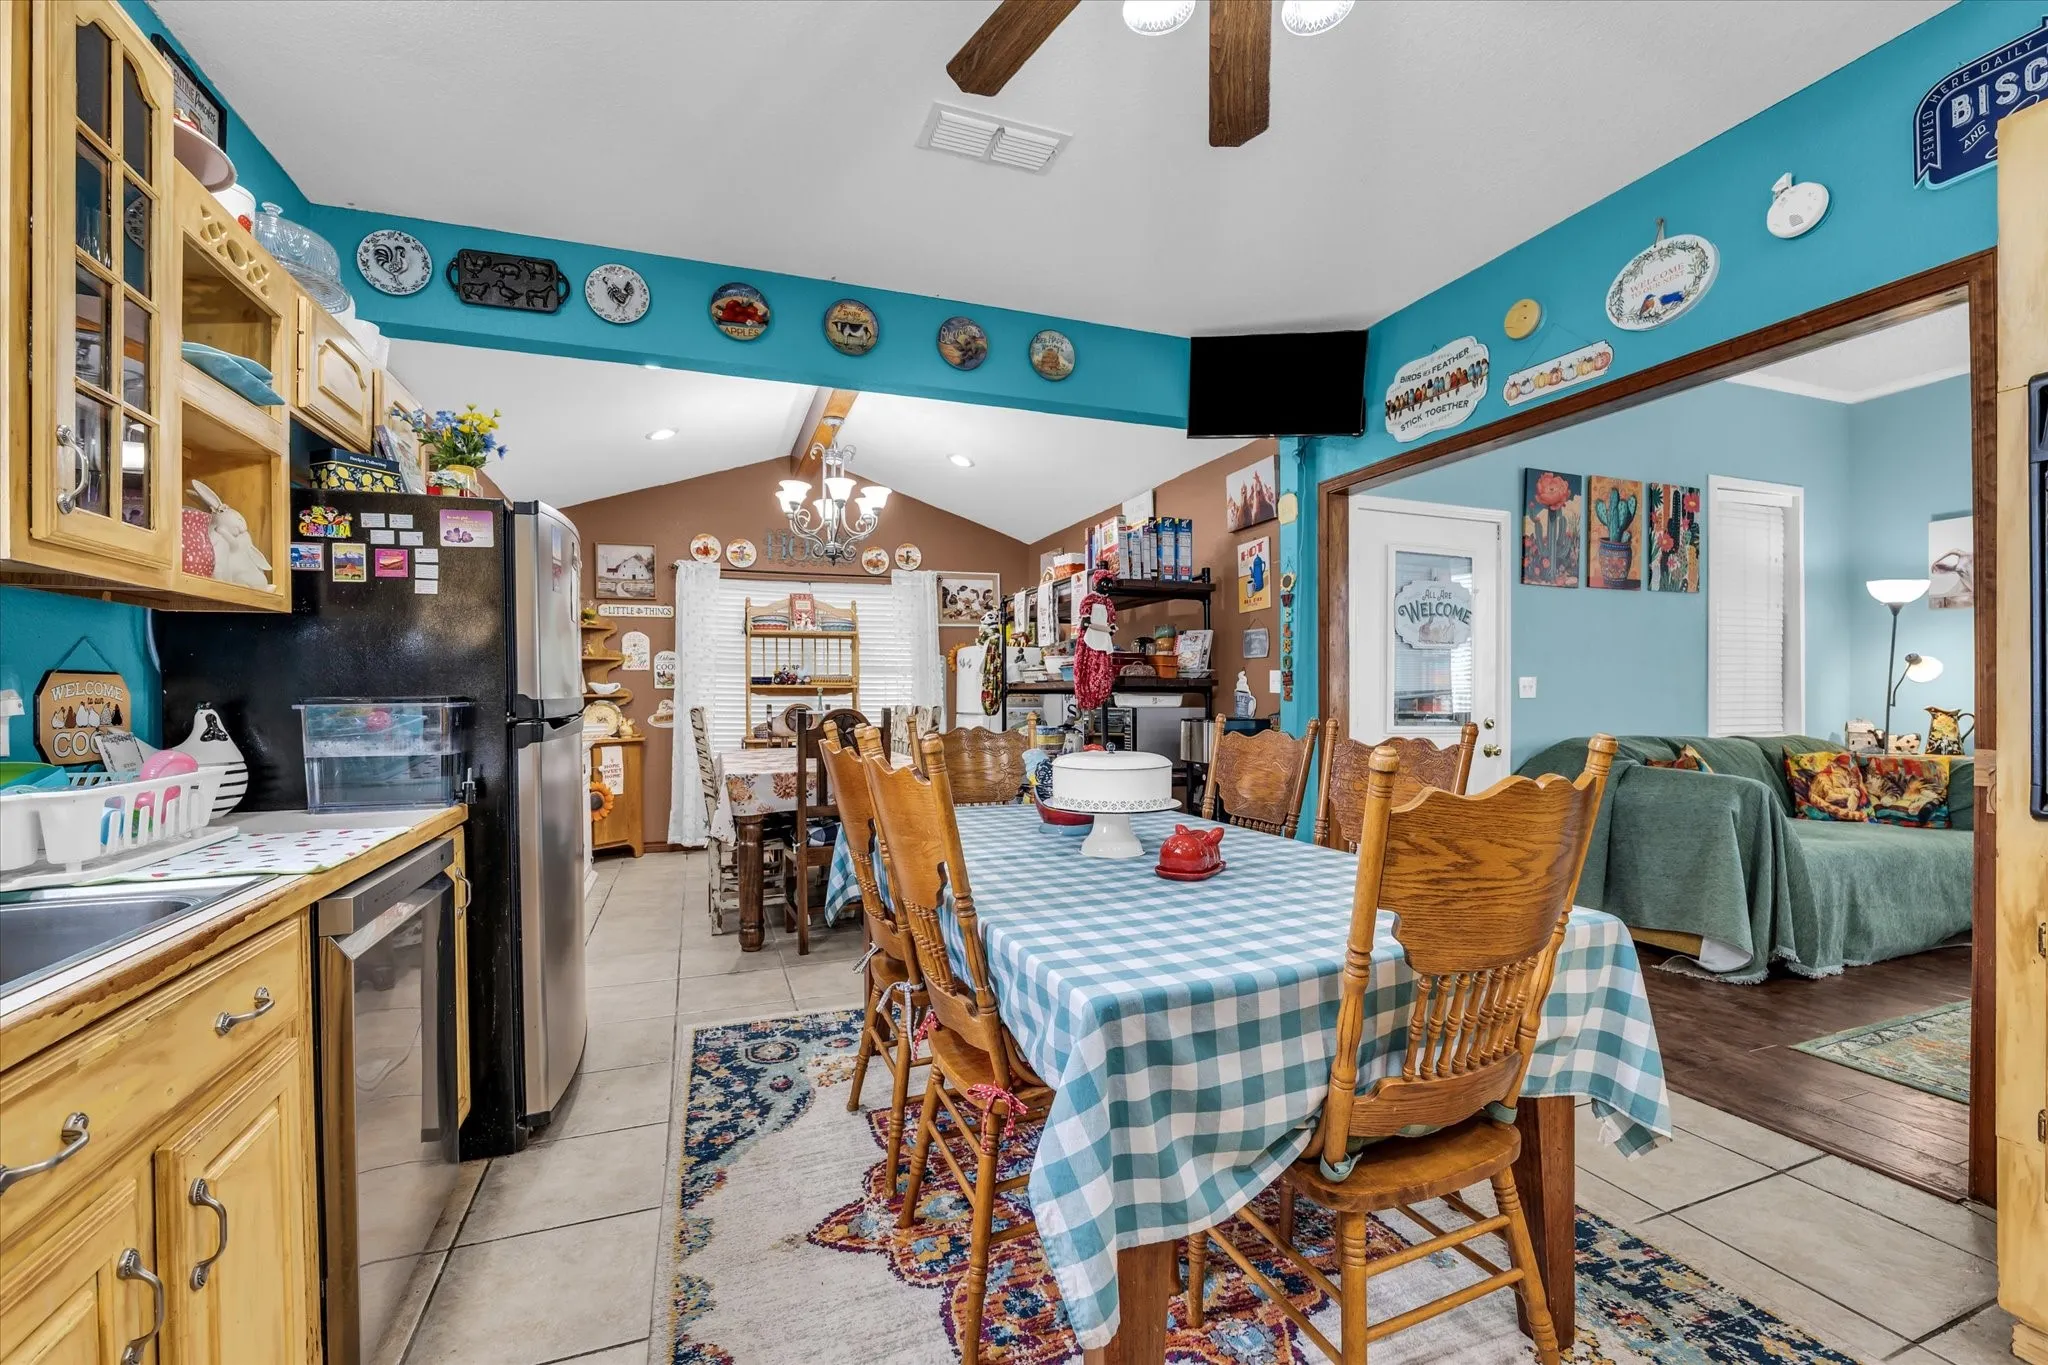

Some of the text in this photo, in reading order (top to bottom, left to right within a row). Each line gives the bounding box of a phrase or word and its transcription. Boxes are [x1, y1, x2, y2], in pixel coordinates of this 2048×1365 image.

[1922, 110, 1935, 160] SERVED
[1929, 71, 1970, 104] HERE
[1981, 39, 2033, 73] DAILY
[1964, 124, 1987, 149] AND
[1630, 263, 1685, 293] WELCOME
[724, 327, 759, 337] APPLES
[1400, 372, 1422, 383] BIRDS
[1431, 346, 1470, 374] FEATHER
[1400, 399, 1470, 432] STICK TOGETHER
[1241, 541, 1264, 562] HOT
[608, 606, 635, 616] LITTLE
[644, 608, 672, 617] THINGS
[1398, 600, 1473, 625] WELCOME
[1281, 593, 1294, 702] WELCOME
[51, 680, 124, 702] WELCOME
[53, 730, 101, 758] COO
